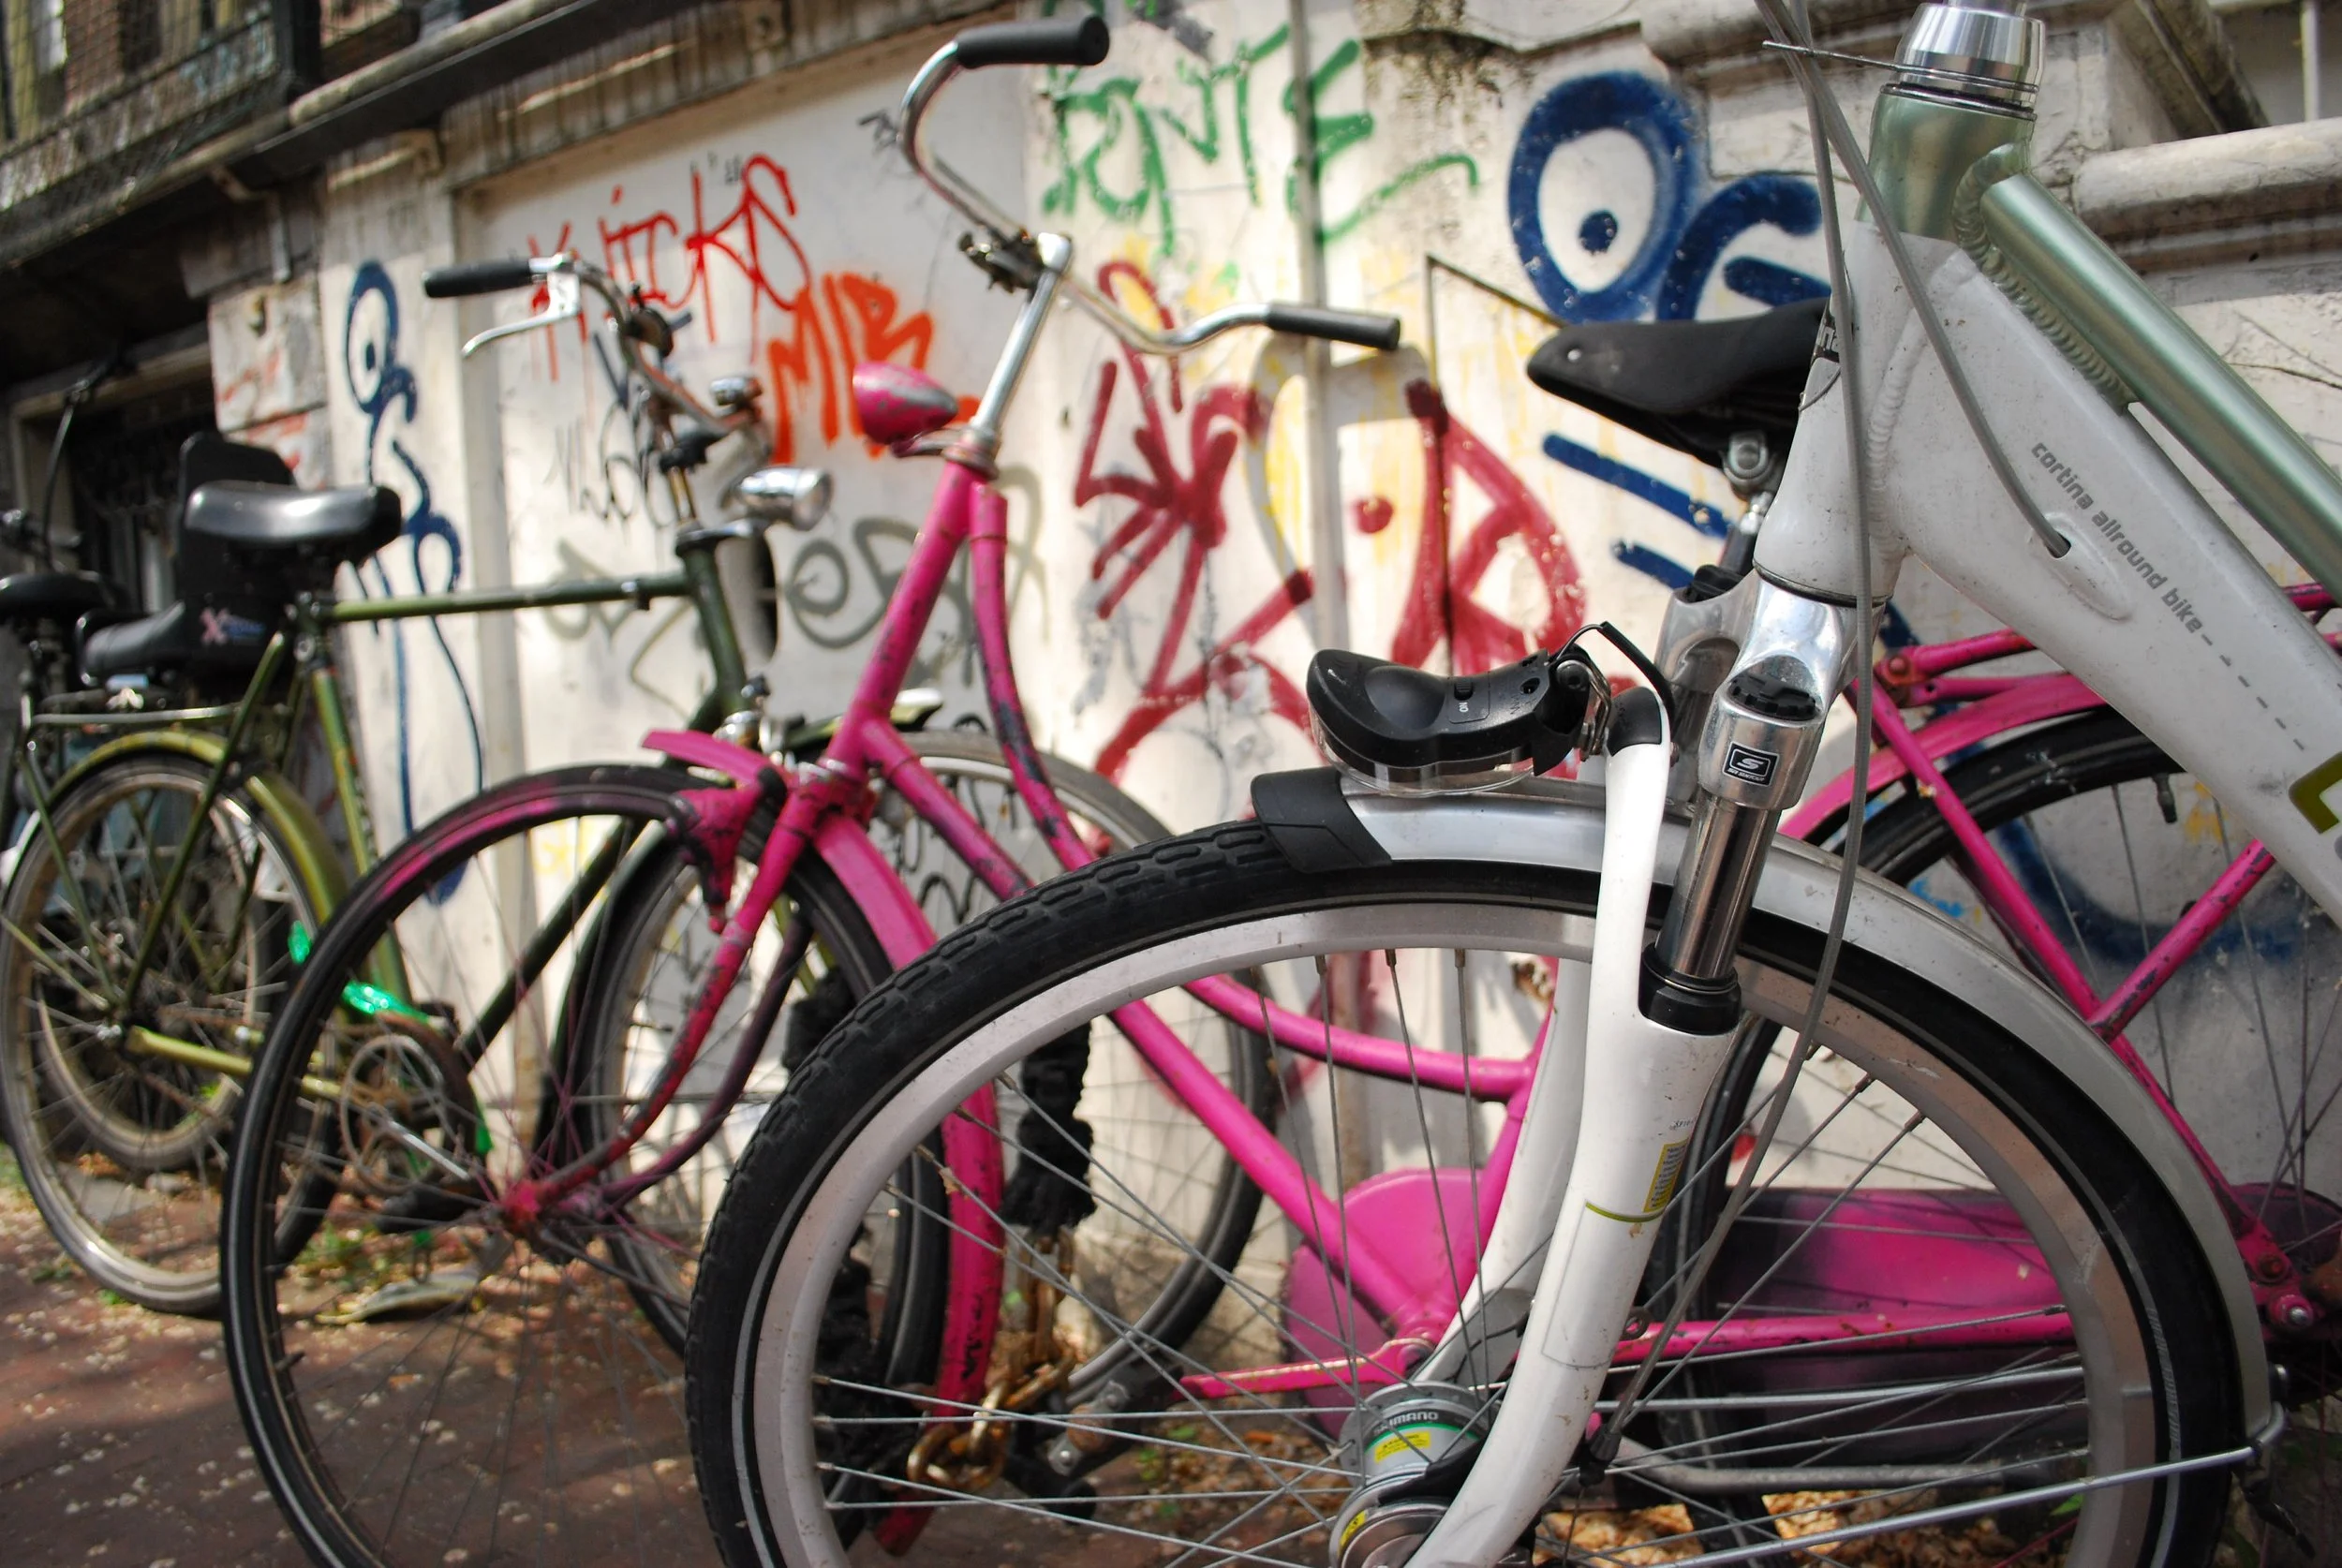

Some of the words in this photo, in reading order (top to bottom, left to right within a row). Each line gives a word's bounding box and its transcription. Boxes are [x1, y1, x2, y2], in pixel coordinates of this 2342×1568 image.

[2031, 442, 2094, 510] cortina
[2091, 510, 2169, 590] allround
[2160, 587, 2203, 634] bike
[1459, 702, 1470, 713] ON
